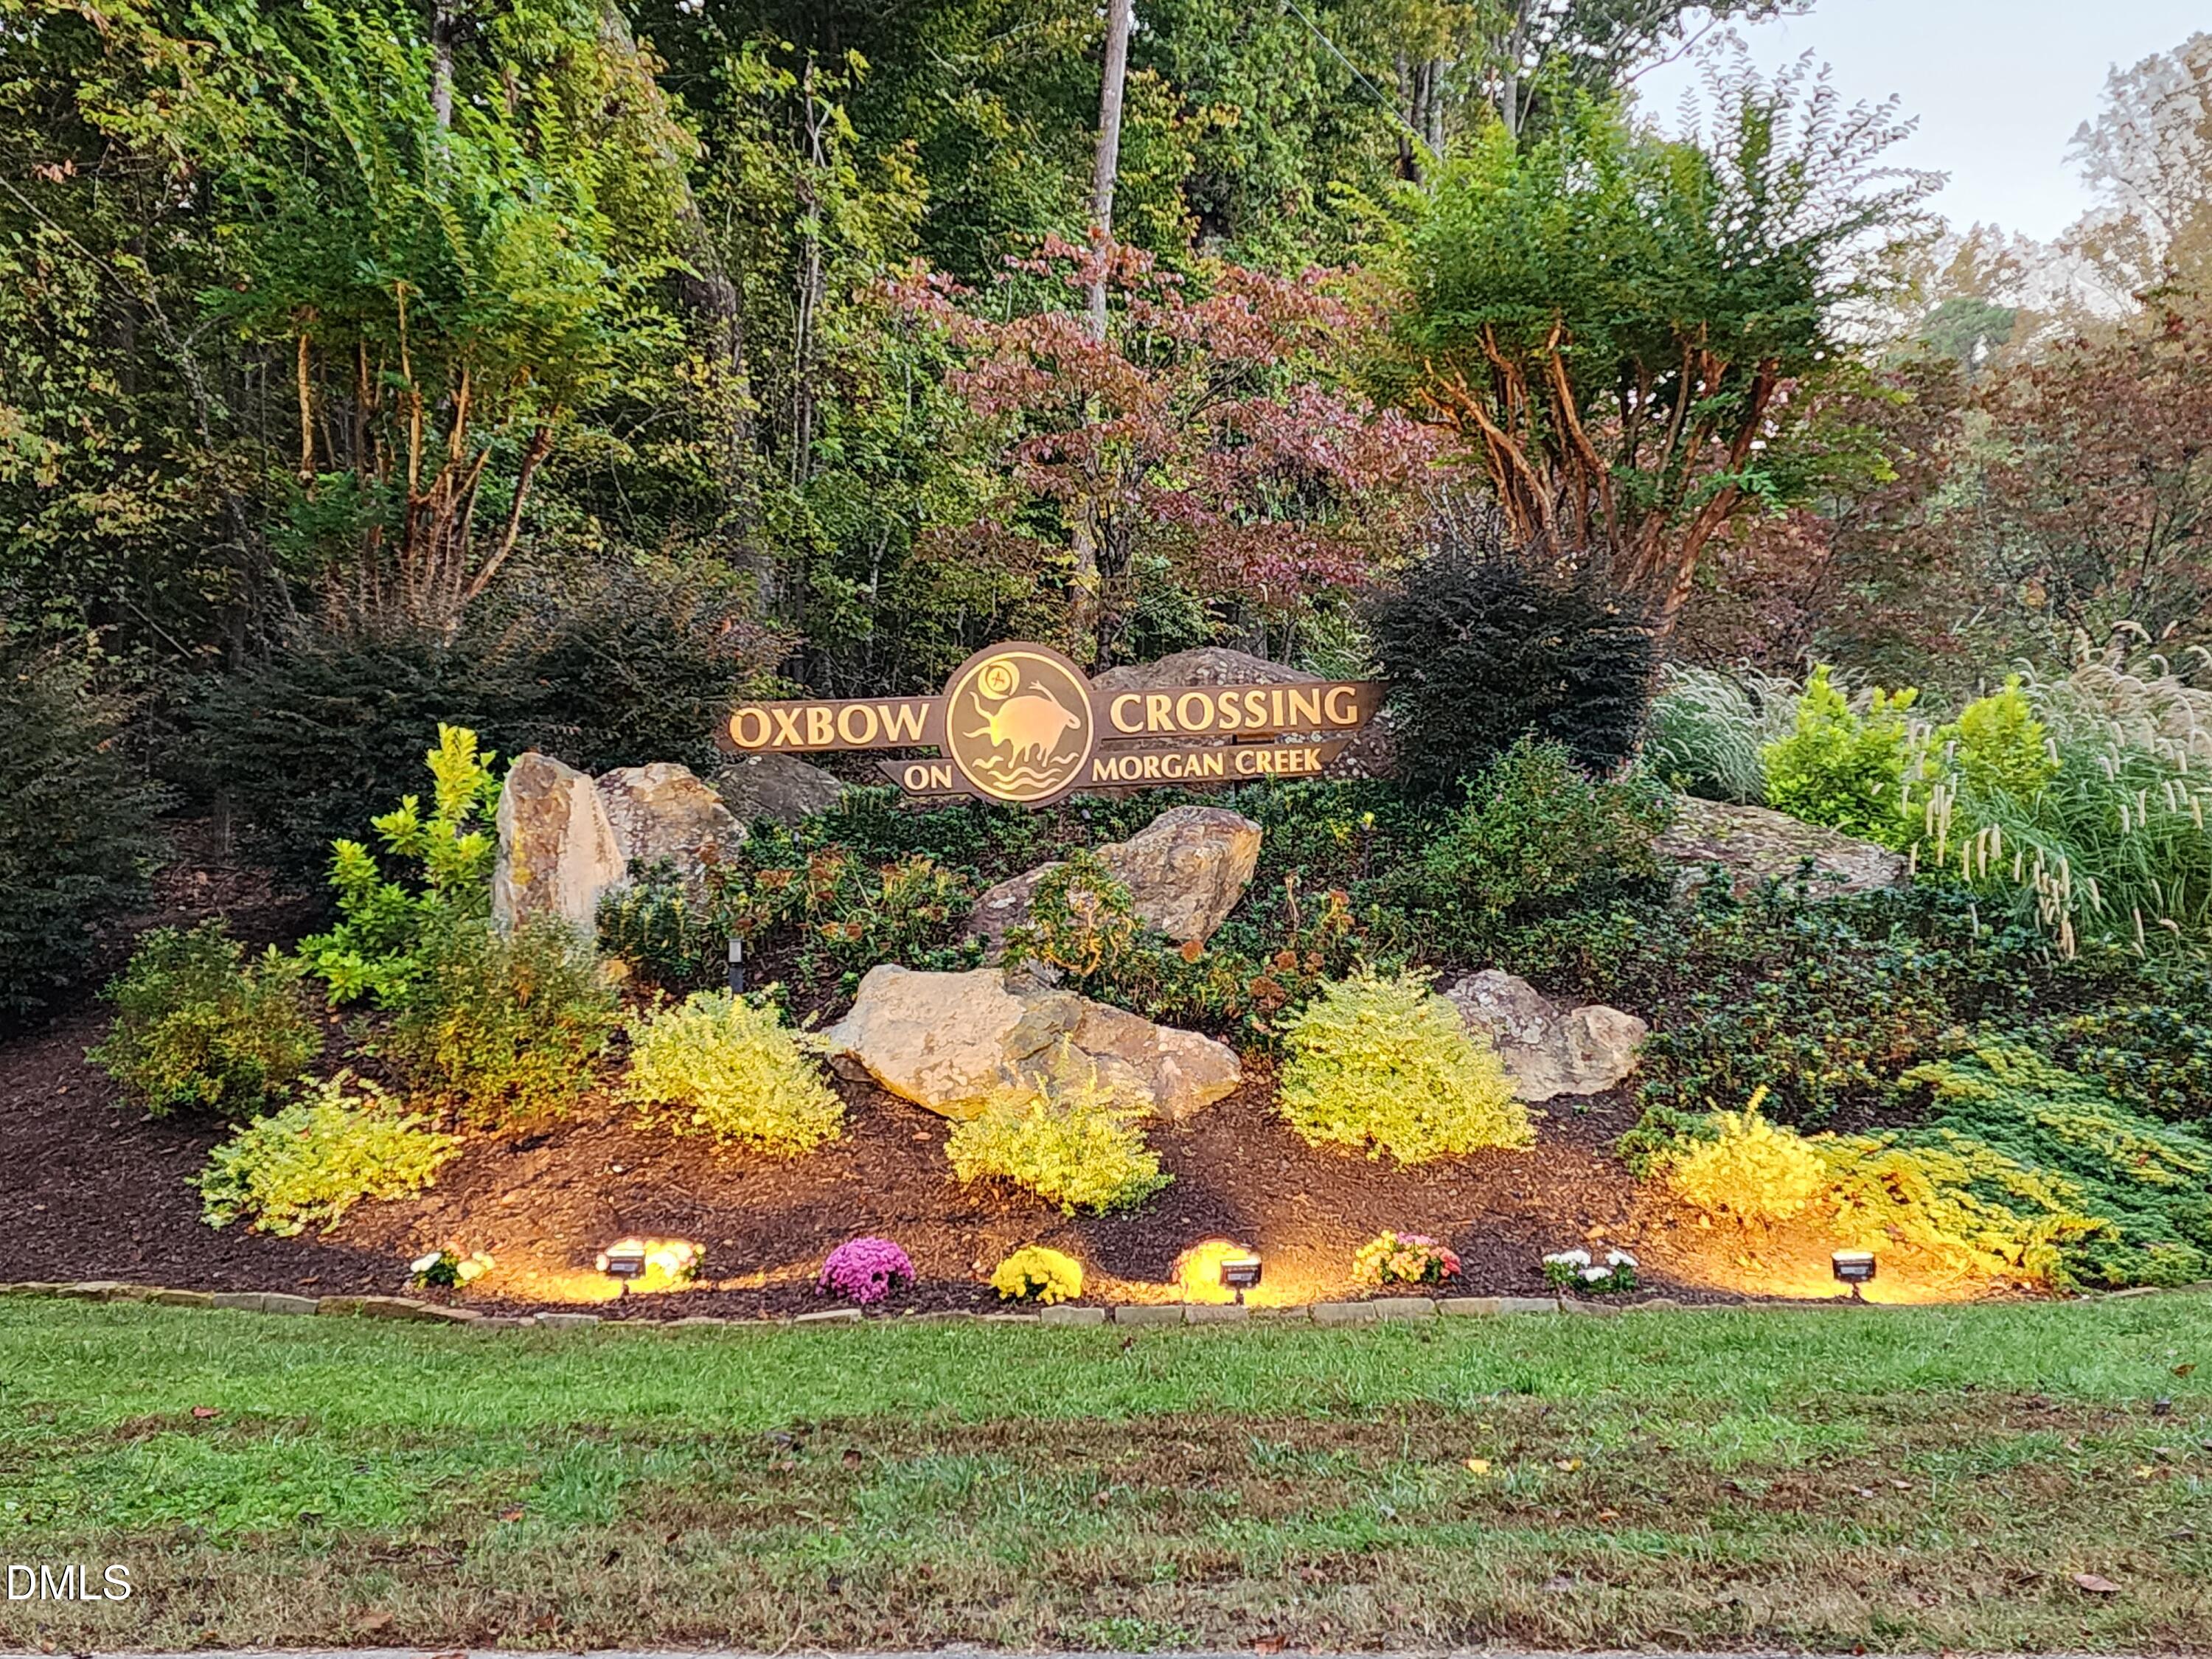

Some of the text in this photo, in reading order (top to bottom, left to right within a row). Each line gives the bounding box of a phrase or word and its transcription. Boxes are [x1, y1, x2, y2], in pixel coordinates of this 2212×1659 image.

[729, 686, 1358, 748] OXBOW CROSSING
[903, 748, 1323, 790] ON MORGAN CREEK
